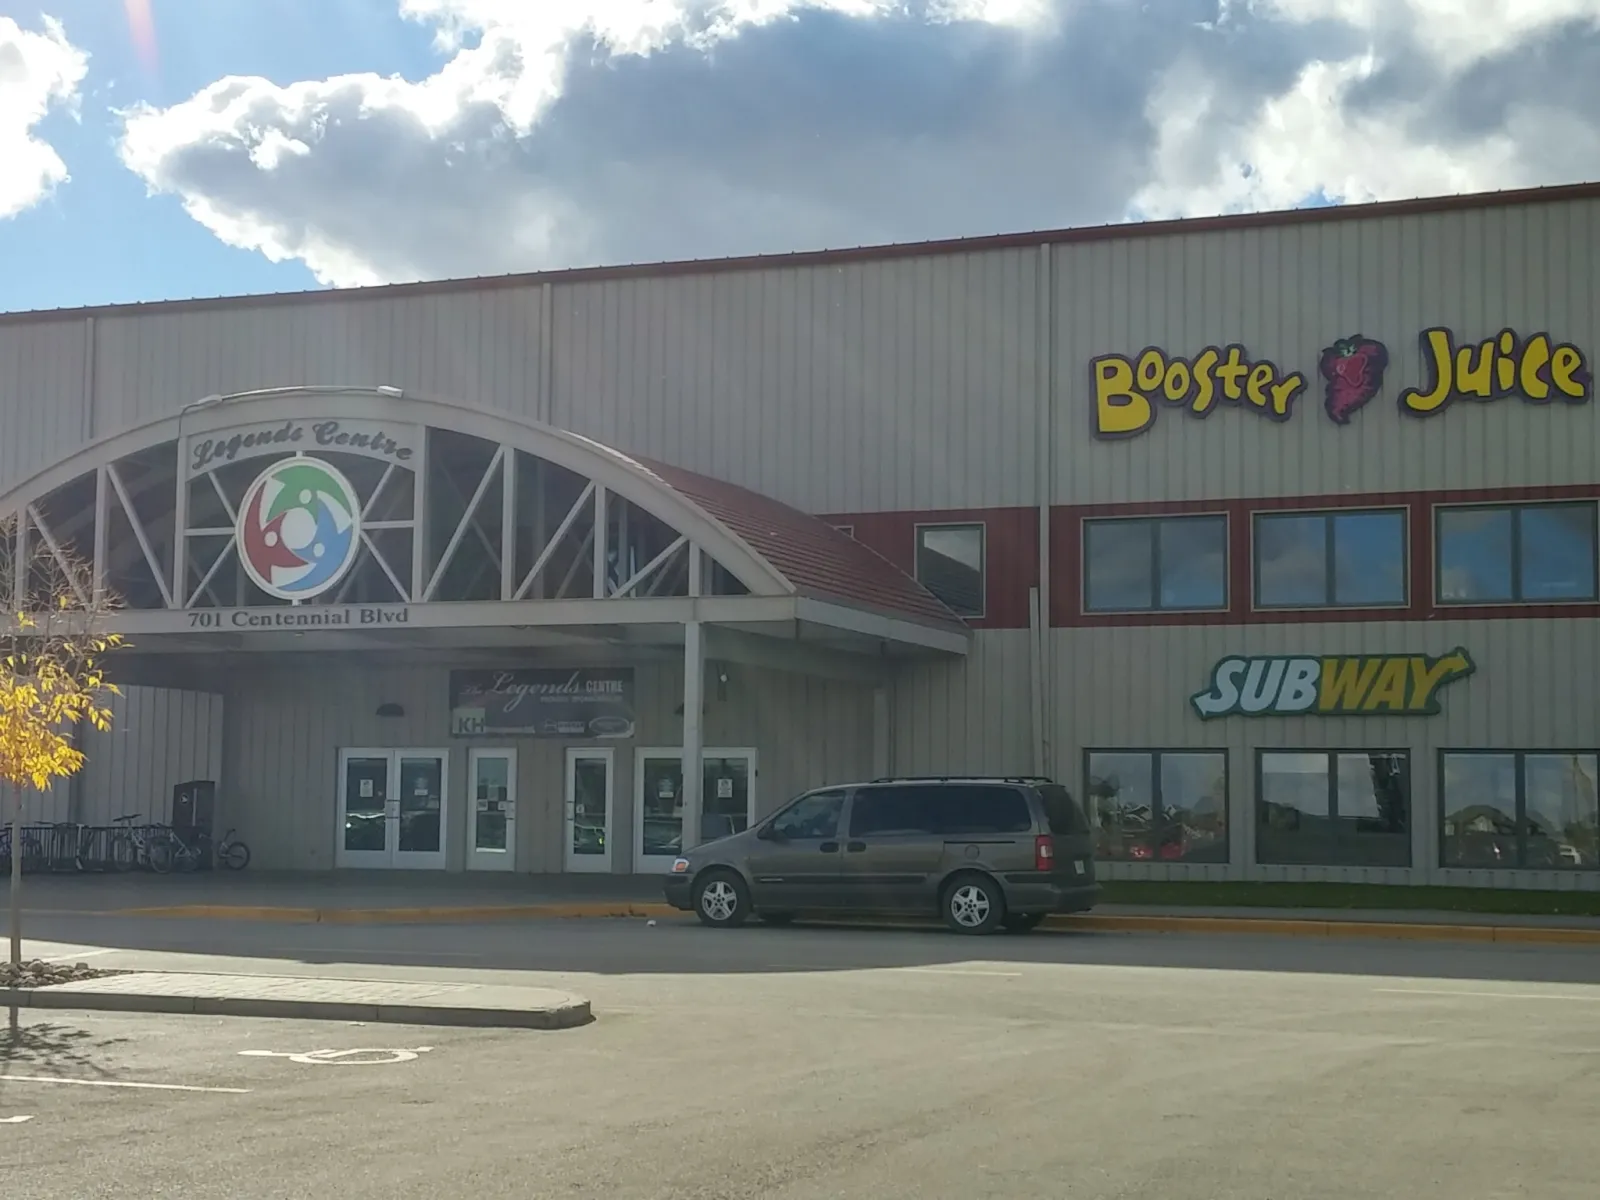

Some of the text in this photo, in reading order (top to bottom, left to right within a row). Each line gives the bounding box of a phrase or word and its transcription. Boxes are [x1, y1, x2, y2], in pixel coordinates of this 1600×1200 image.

[1093, 328, 1587, 435] Booster Juice
[192, 421, 413, 470] Legends Centre
[188, 607, 408, 628] 701 Centennial Blvd
[485, 670, 580, 713] Legends
[585, 679, 624, 693] CENTRE
[1195, 652, 1469, 715] SUBWAY
